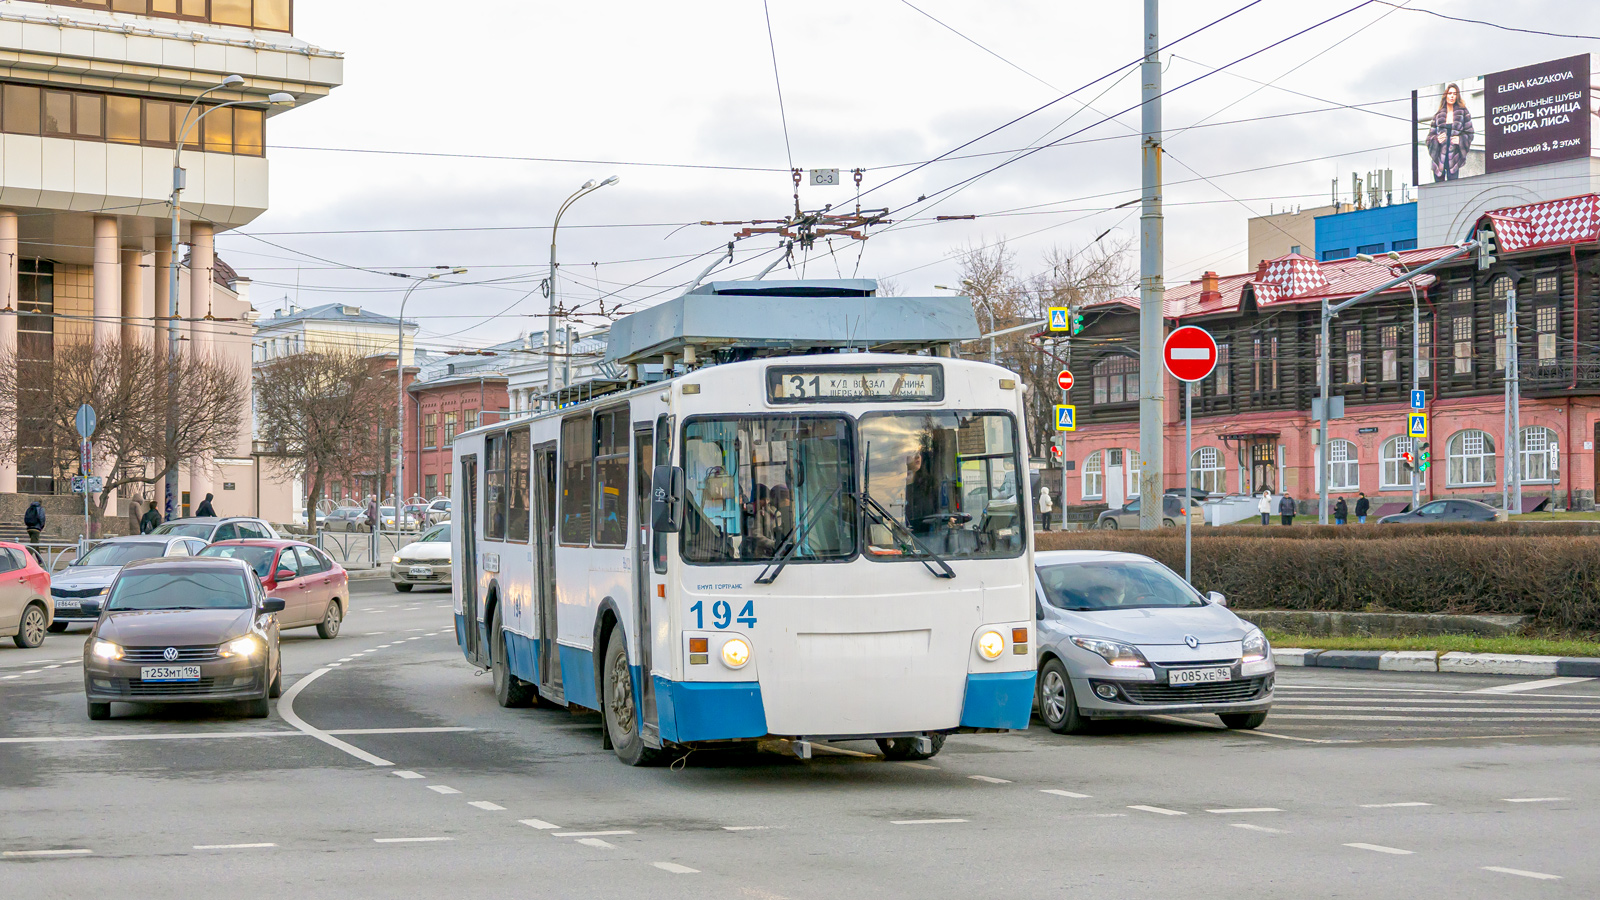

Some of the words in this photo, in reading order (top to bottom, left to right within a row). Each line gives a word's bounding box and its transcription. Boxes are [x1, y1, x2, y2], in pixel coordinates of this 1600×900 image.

[1498, 81, 1525, 93] ELENA
[1526, 71, 1574, 87] KAZAKOVA
[1492, 96, 1554, 115] ПРЕМИАЛЬНЫЕ
[1555, 91, 1582, 102] ШУБЫ
[1492, 111, 1535, 126] СОБОЛЬ
[1536, 102, 1581, 118] КУНИЦА
[1503, 121, 1538, 135] НОРКА
[1540, 114, 1570, 127] ЛИСА
[1493, 144, 1541, 160] БАНКОВСКИЙ
[1542, 141, 1551, 152] 3,
[1552, 140, 1559, 149] 2
[1559, 138, 1581, 148] ЭТАЖ
[789, 375, 821, 398] 31
[690, 600, 758, 629] 194
[144, 668, 181, 678] Т253МТ
[183, 666, 199, 675] 196
[1217, 669, 1228, 677] 96
